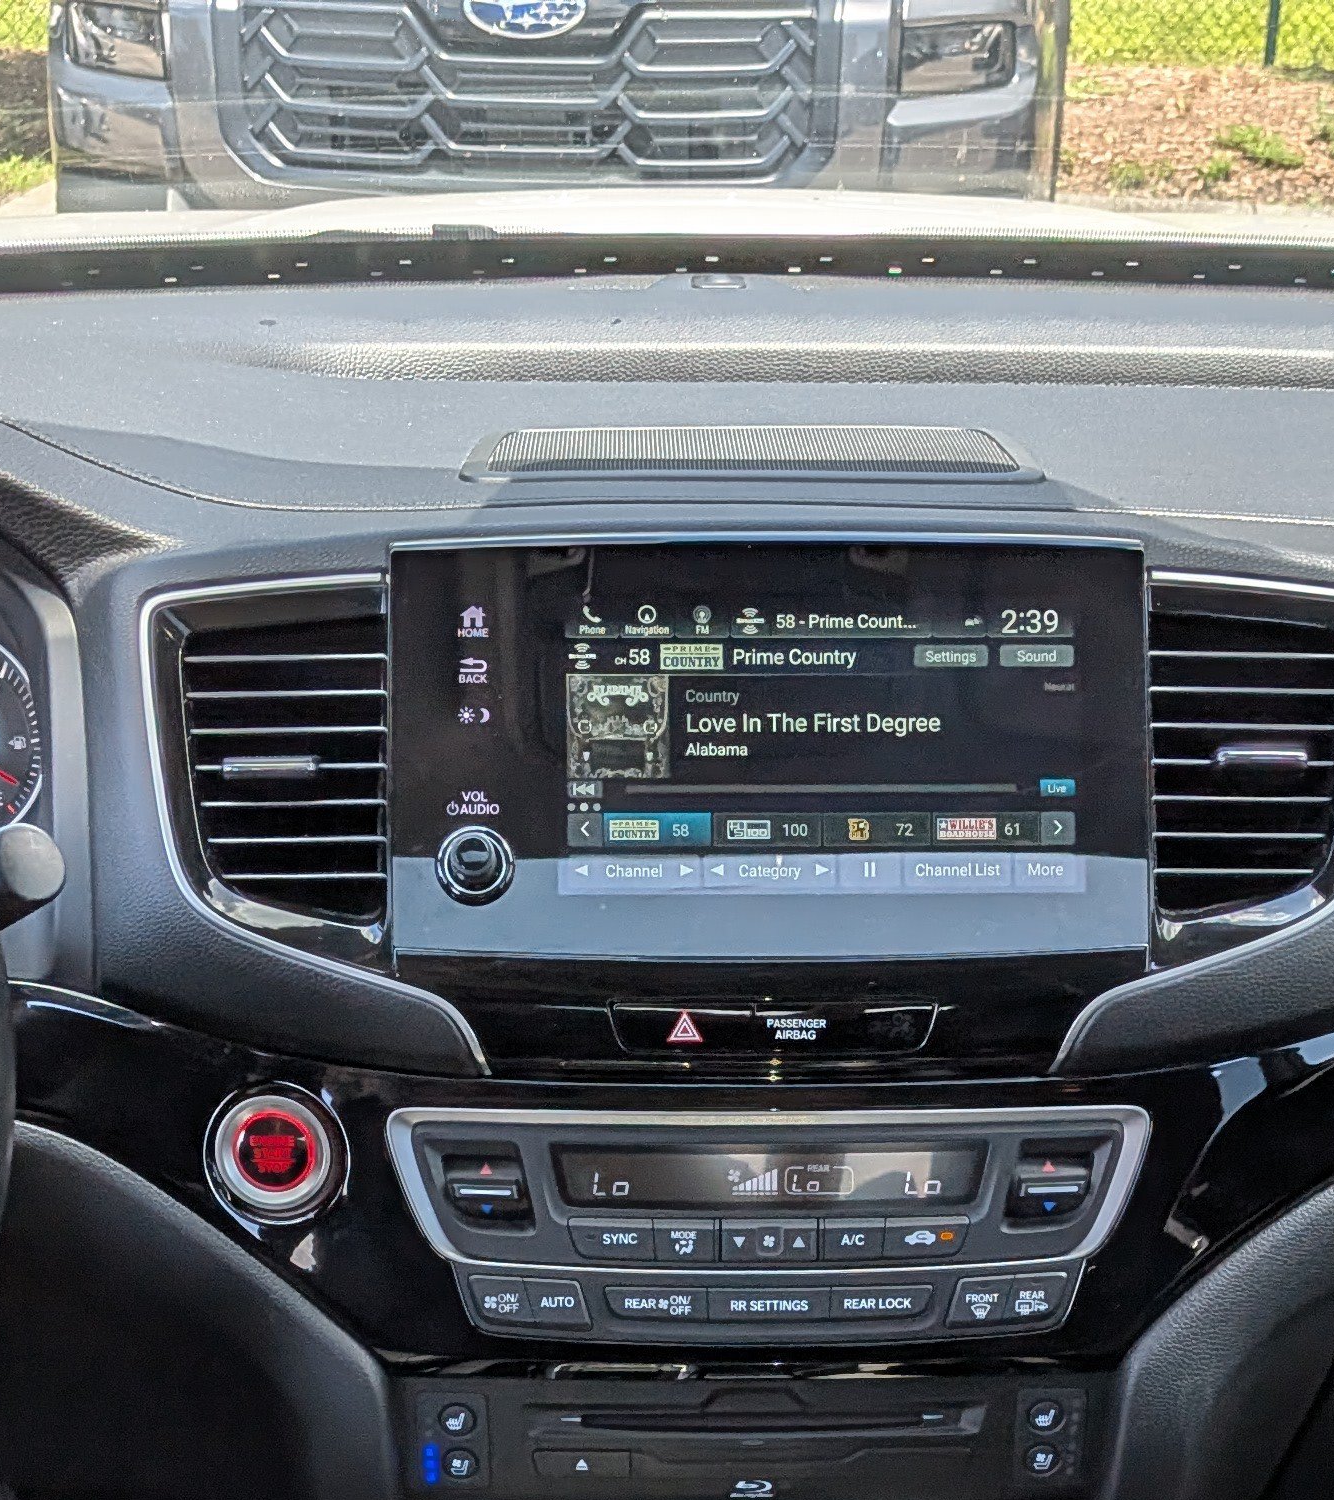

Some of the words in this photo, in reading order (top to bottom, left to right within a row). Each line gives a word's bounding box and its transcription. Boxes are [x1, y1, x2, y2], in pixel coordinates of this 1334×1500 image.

[776, 614, 796, 629] 58
[808, 614, 853, 629] Prime
[857, 614, 917, 629] Count...
[1001, 609, 1059, 634] 2:39
[457, 628, 489, 638] HOME
[579, 625, 606, 636] Phone
[625, 625, 670, 637] Navigation
[695, 625, 710, 635] FM
[614, 656, 627, 666] CH
[628, 648, 651, 666] 58
[662, 656, 721, 668] COUNTRY
[733, 649, 784, 665] Prime
[788, 649, 857, 669] Country
[925, 651, 977, 665] Settings
[1017, 650, 1057, 663] Sound
[458, 674, 488, 684] BACK
[685, 689, 740, 706] Country
[686, 713, 736, 733] Love
[742, 713, 761, 733] In
[767, 713, 807, 733] The
[813, 713, 861, 733] First
[867, 713, 941, 737] Degree
[685, 743, 748, 756] Alabama
[1047, 783, 1067, 793] Live
[462, 791, 488, 802] VOL
[460, 803, 500, 815] AUDIO
[672, 824, 690, 837] 58
[782, 823, 808, 837] 100
[896, 823, 914, 837] 72
[949, 819, 994, 830] WILLIE'S
[1004, 823, 1020, 836] 61
[612, 830, 657, 839] COUNTRY
[605, 864, 663, 878] Channel
[738, 864, 801, 880] Category
[916, 863, 971, 876] Channel
[975, 863, 1000, 876] List
[1028, 863, 1064, 876] More
[767, 1018, 826, 1029] PASSENGER
[775, 1030, 816, 1040] AIRBAG
[807, 1164, 830, 1173] REAR
[602, 1233, 638, 1246] SYNC
[671, 1231, 697, 1241] MODE
[841, 1233, 865, 1247] A/C
[497, 1293, 519, 1303] ON/
[669, 1295, 691, 1306] ON/
[966, 1293, 999, 1303] FRONT
[1019, 1290, 1045, 1300] REAR
[540, 1296, 574, 1308] AUTO
[624, 1298, 657, 1309] REAR
[730, 1301, 748, 1312] RR
[749, 1300, 809, 1312] SETTINGS
[844, 1298, 876, 1310] REAR
[878, 1298, 912, 1309] LOCK
[498, 1303, 519, 1314] OFF
[670, 1305, 691, 1316] OFF
